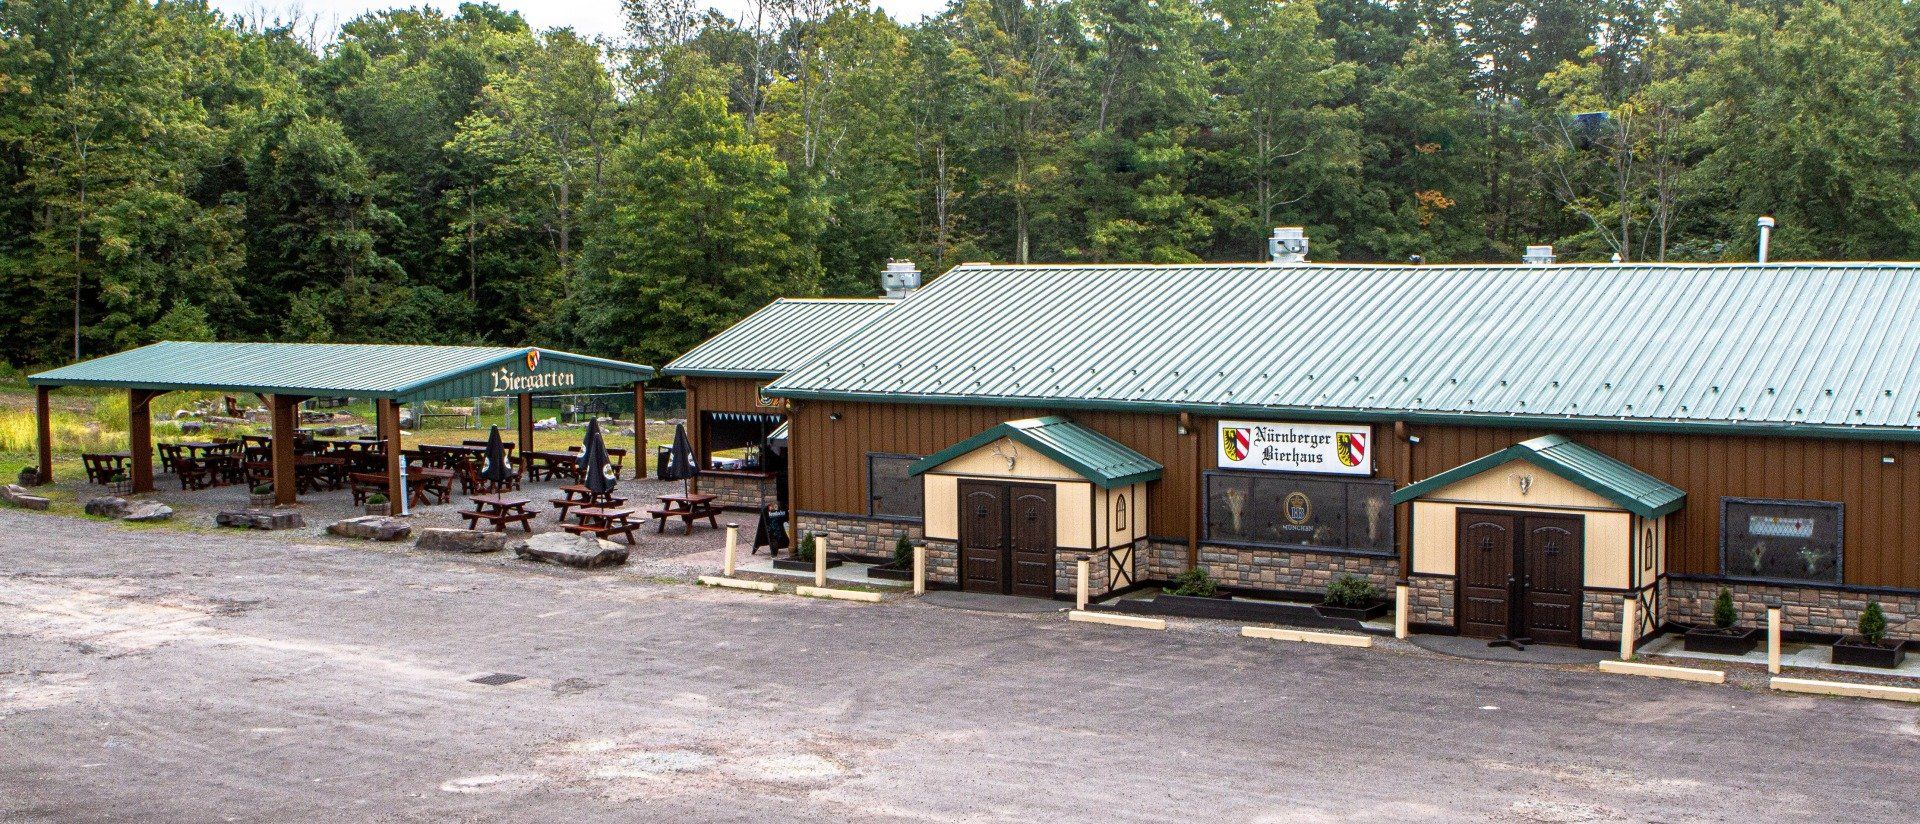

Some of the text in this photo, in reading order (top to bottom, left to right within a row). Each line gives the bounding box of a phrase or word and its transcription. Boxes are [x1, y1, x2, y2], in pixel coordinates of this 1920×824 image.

[491, 367, 574, 392] Biergarten
[1254, 426, 1331, 448] Nürnberger
[1261, 445, 1323, 467] Bierhaus
